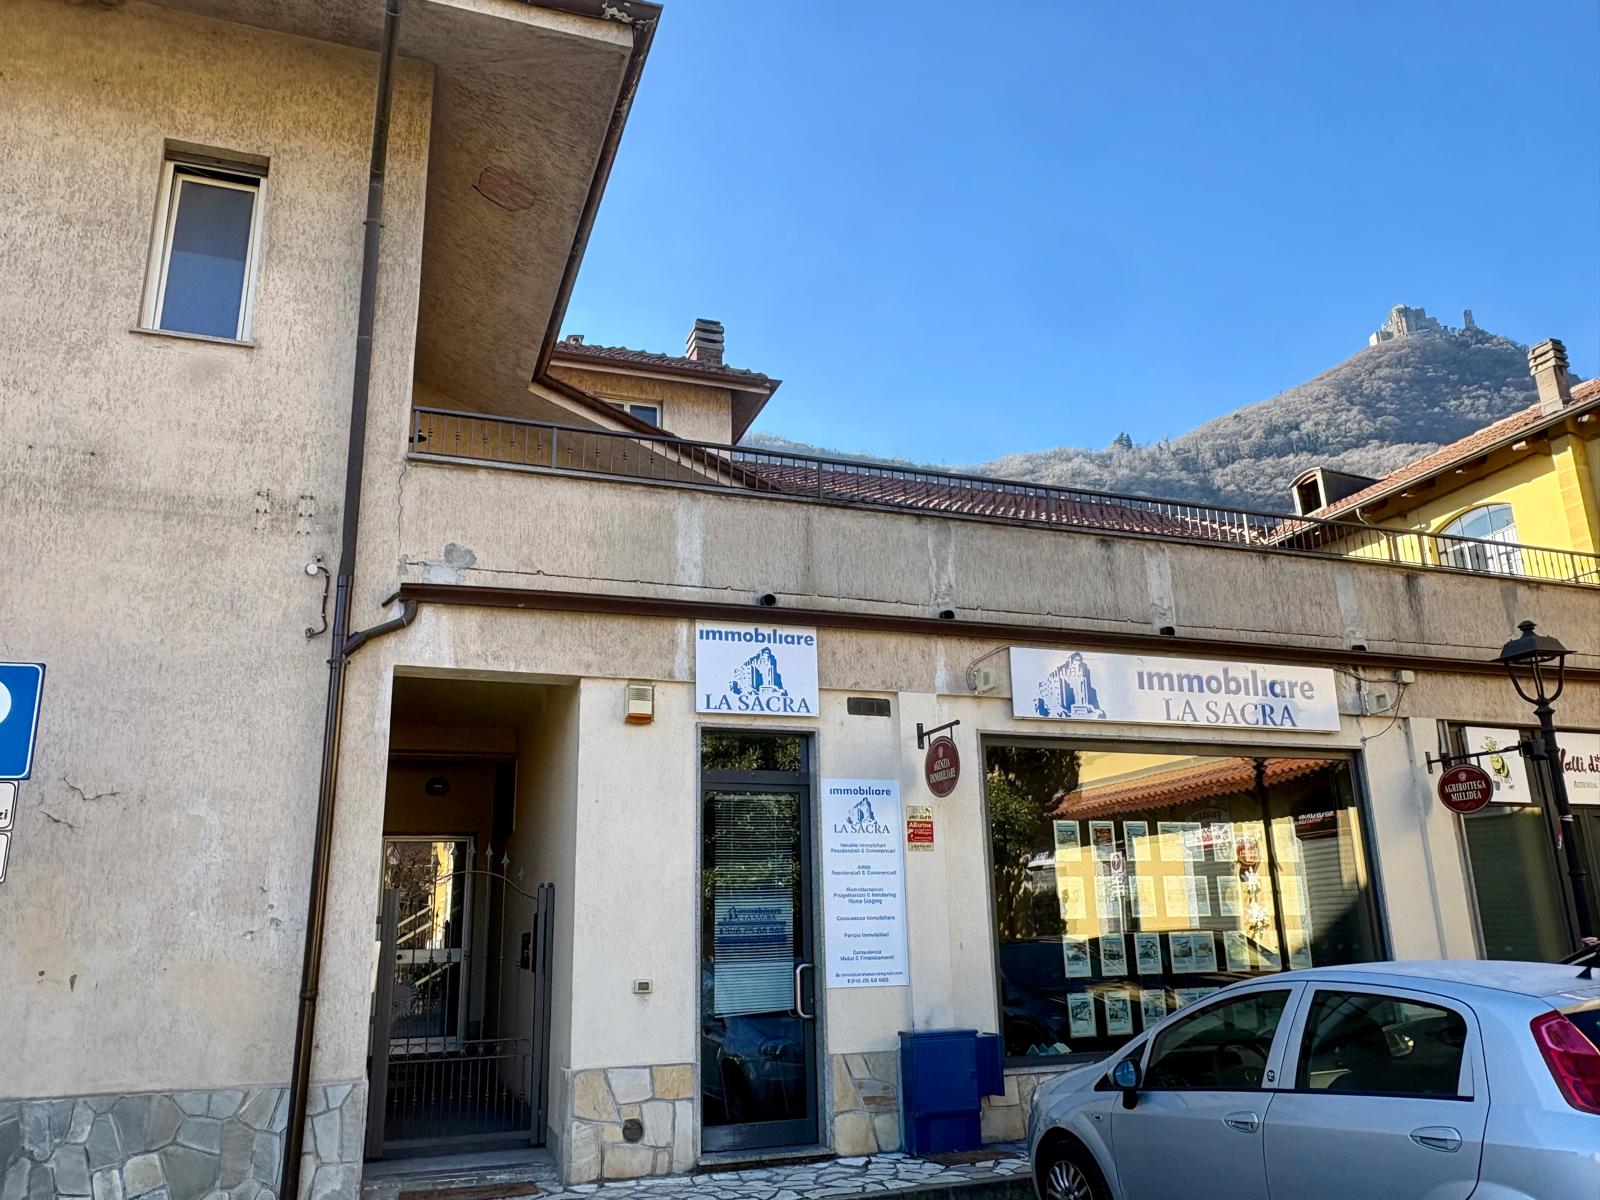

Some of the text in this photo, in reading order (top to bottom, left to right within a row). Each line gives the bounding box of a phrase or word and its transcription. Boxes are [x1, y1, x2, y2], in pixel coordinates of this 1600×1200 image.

[699, 627, 815, 646] immobiliare
[1136, 667, 1315, 700] immobiliare
[704, 693, 812, 713] LA SACRA
[1163, 698, 1298, 727] LA SACRA
[829, 786, 891, 796] immobiliare
[1445, 780, 1486, 793] AGRIBOTTEGA
[1451, 790, 1482, 801] MIELIDEA
[834, 823, 890, 833] LA SACRA
